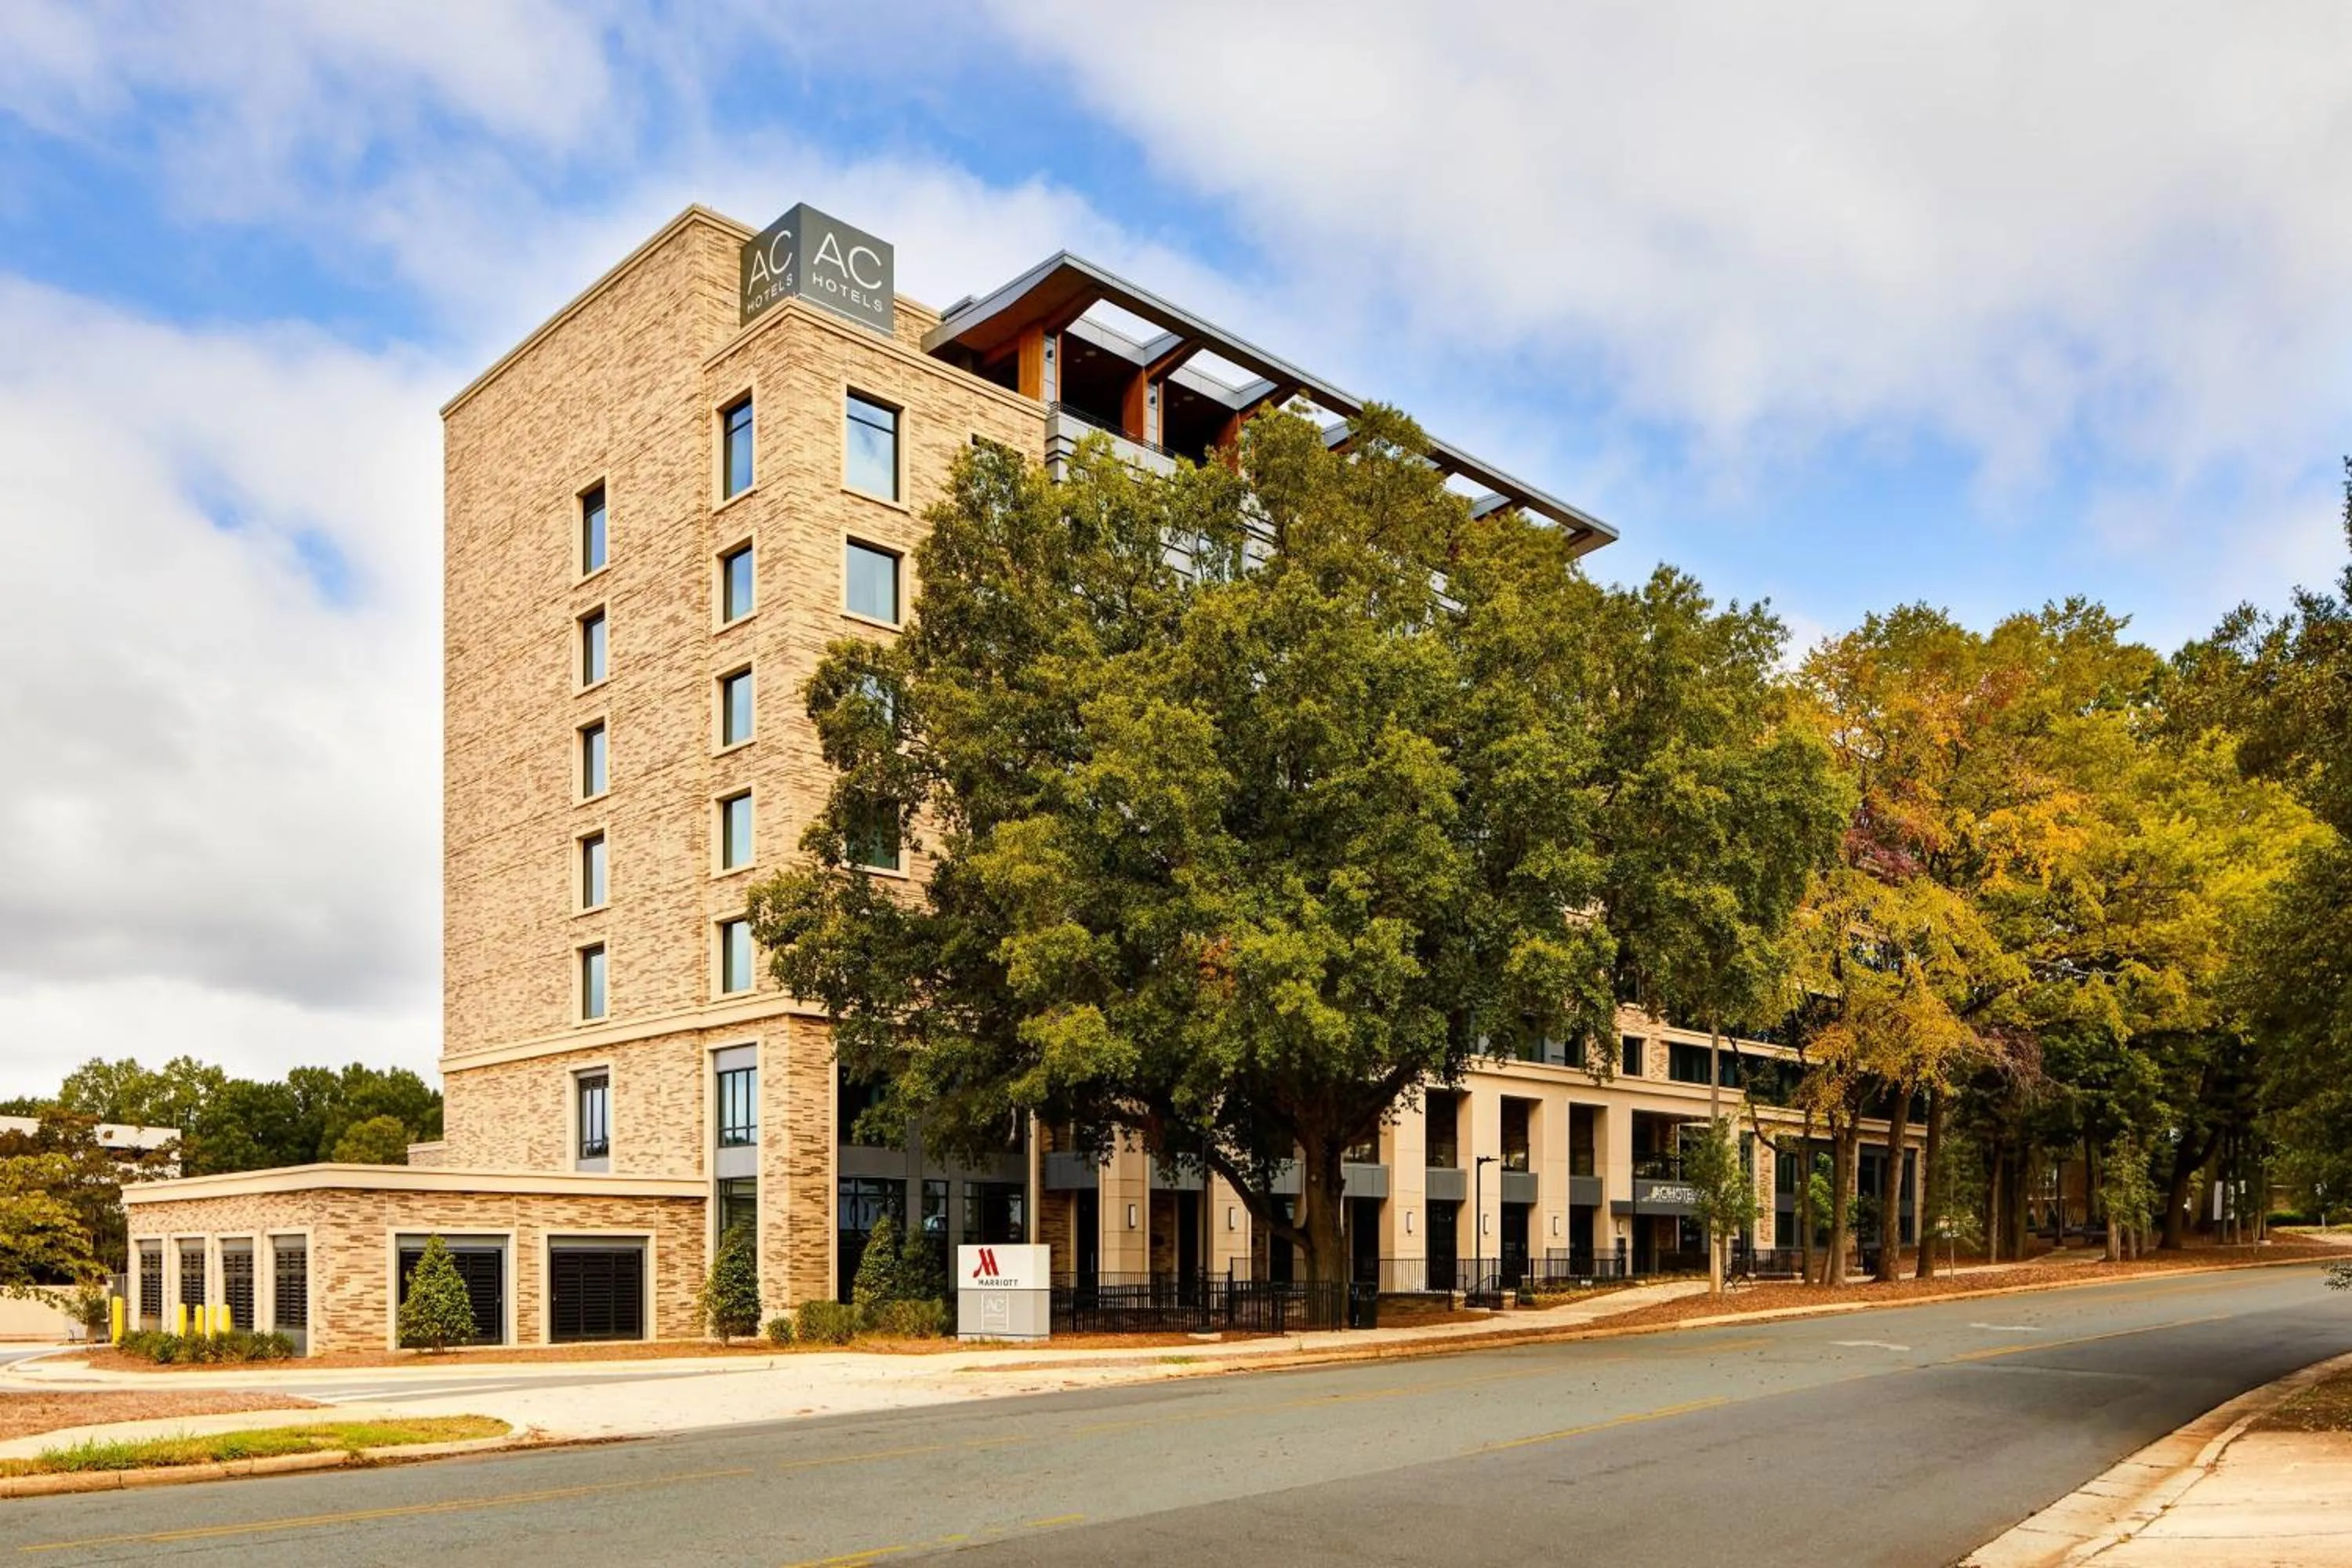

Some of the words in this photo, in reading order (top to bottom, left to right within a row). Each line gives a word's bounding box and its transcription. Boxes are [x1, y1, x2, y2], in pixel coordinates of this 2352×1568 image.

[747, 230, 793, 295] AC
[813, 232, 883, 289] AC
[746, 272, 793, 314] HOTELS
[812, 271, 883, 313] HOTELS
